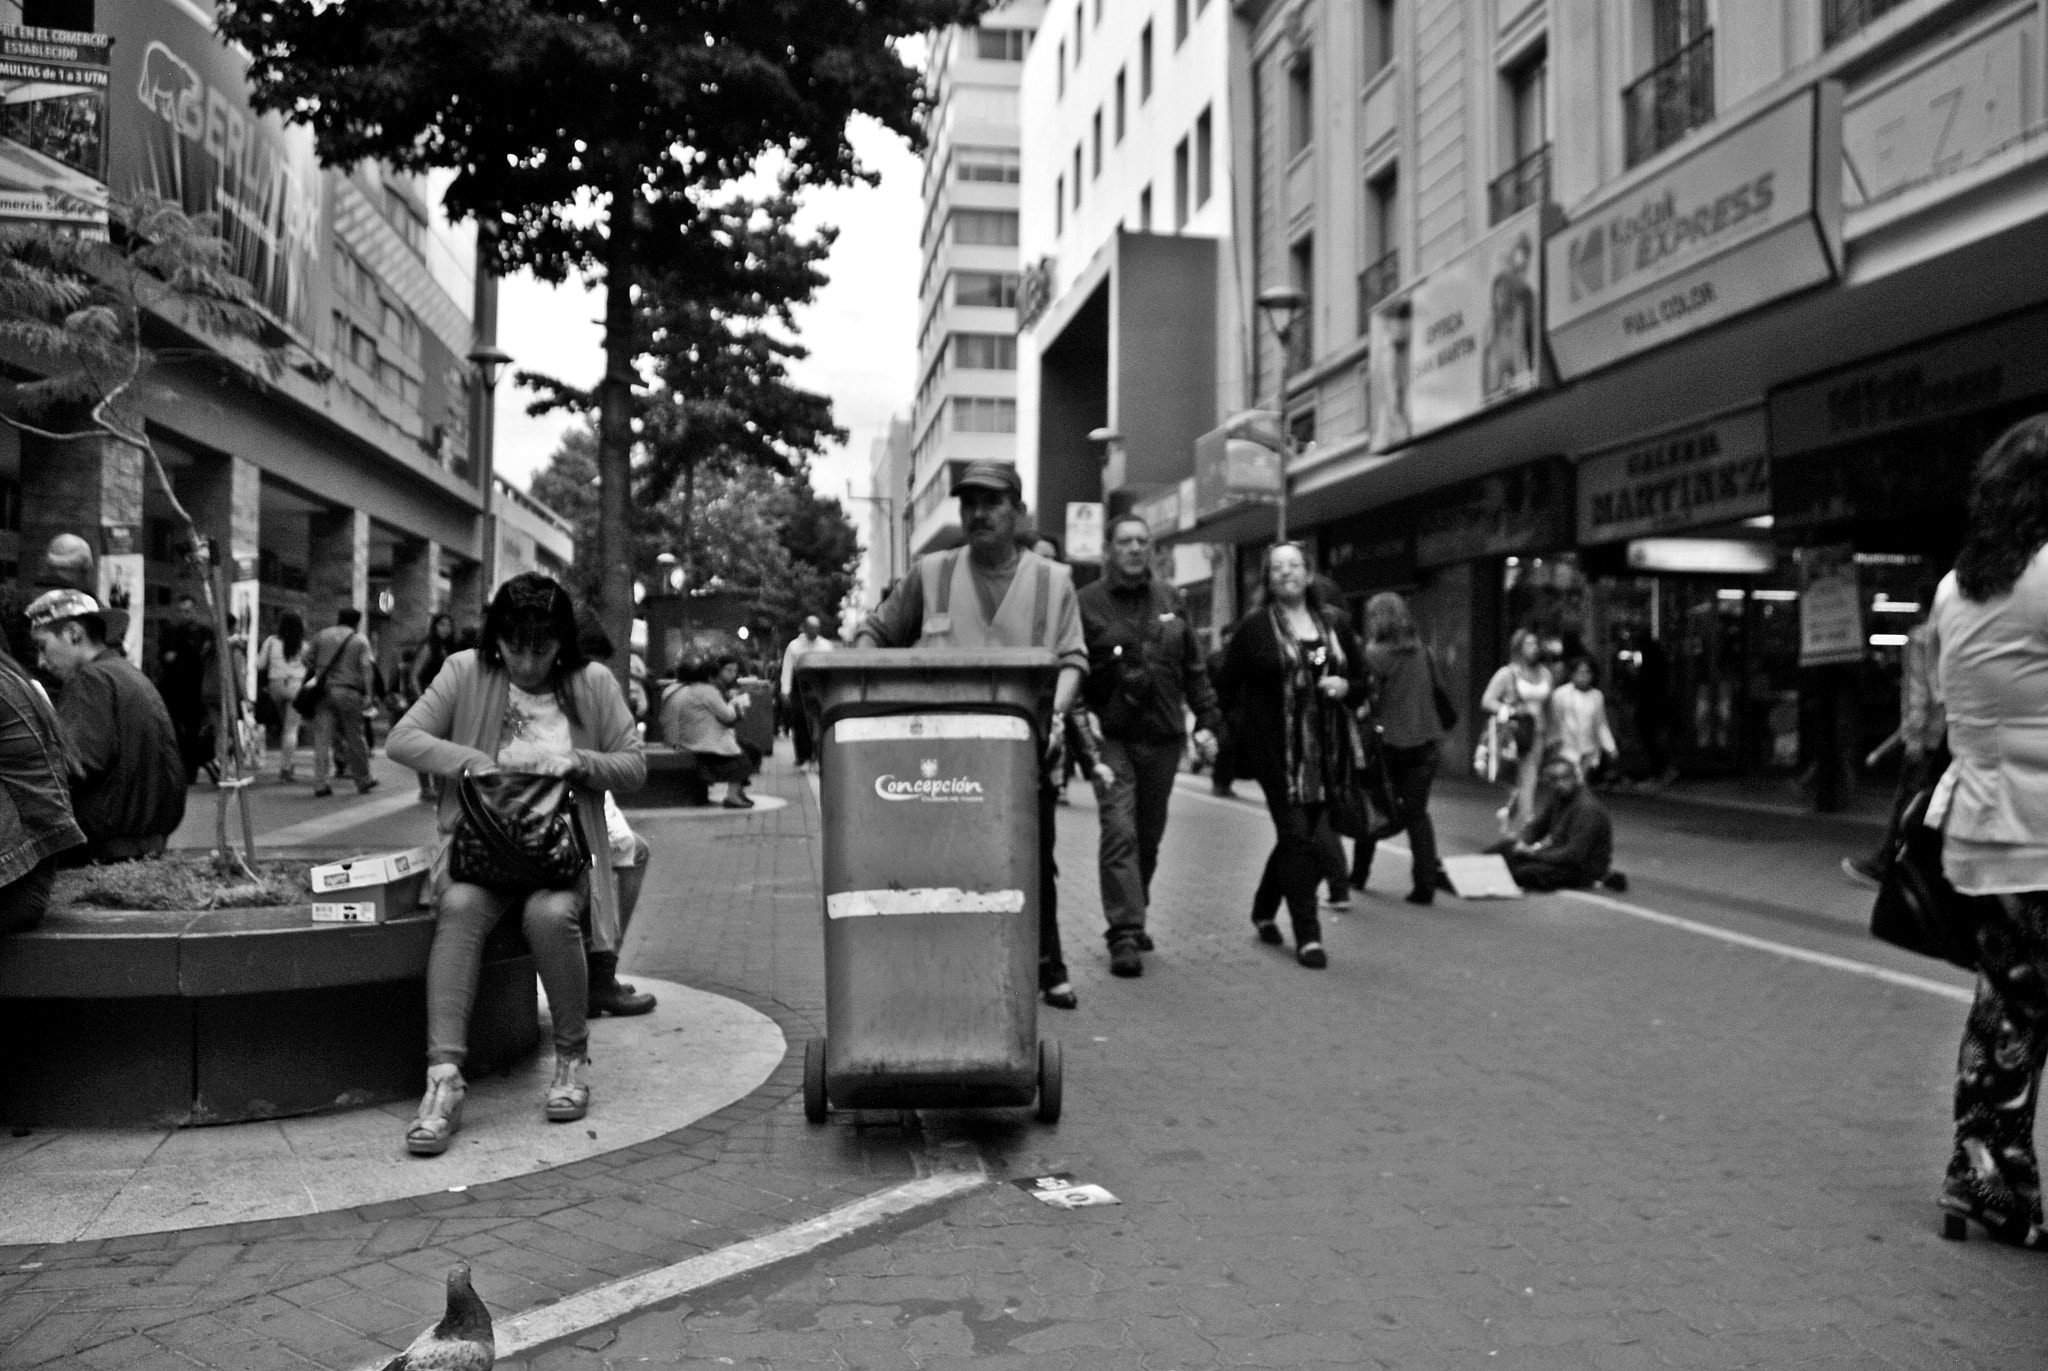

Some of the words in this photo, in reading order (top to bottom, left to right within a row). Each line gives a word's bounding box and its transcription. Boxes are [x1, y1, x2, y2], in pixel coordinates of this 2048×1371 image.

[19, 25, 35, 39] EN
[36, 27, 49, 42] EL
[51, 30, 108, 48] COMERCIO
[4, 40, 78, 60] ESTABLECIDO
[0, 62, 40, 78] MULTAS
[42, 67, 56, 80] de
[59, 69, 64, 80] 1
[84, 71, 108, 85] UTM
[1636, 169, 1776, 270] EXPRESS
[875, 774, 983, 800] Concepción
